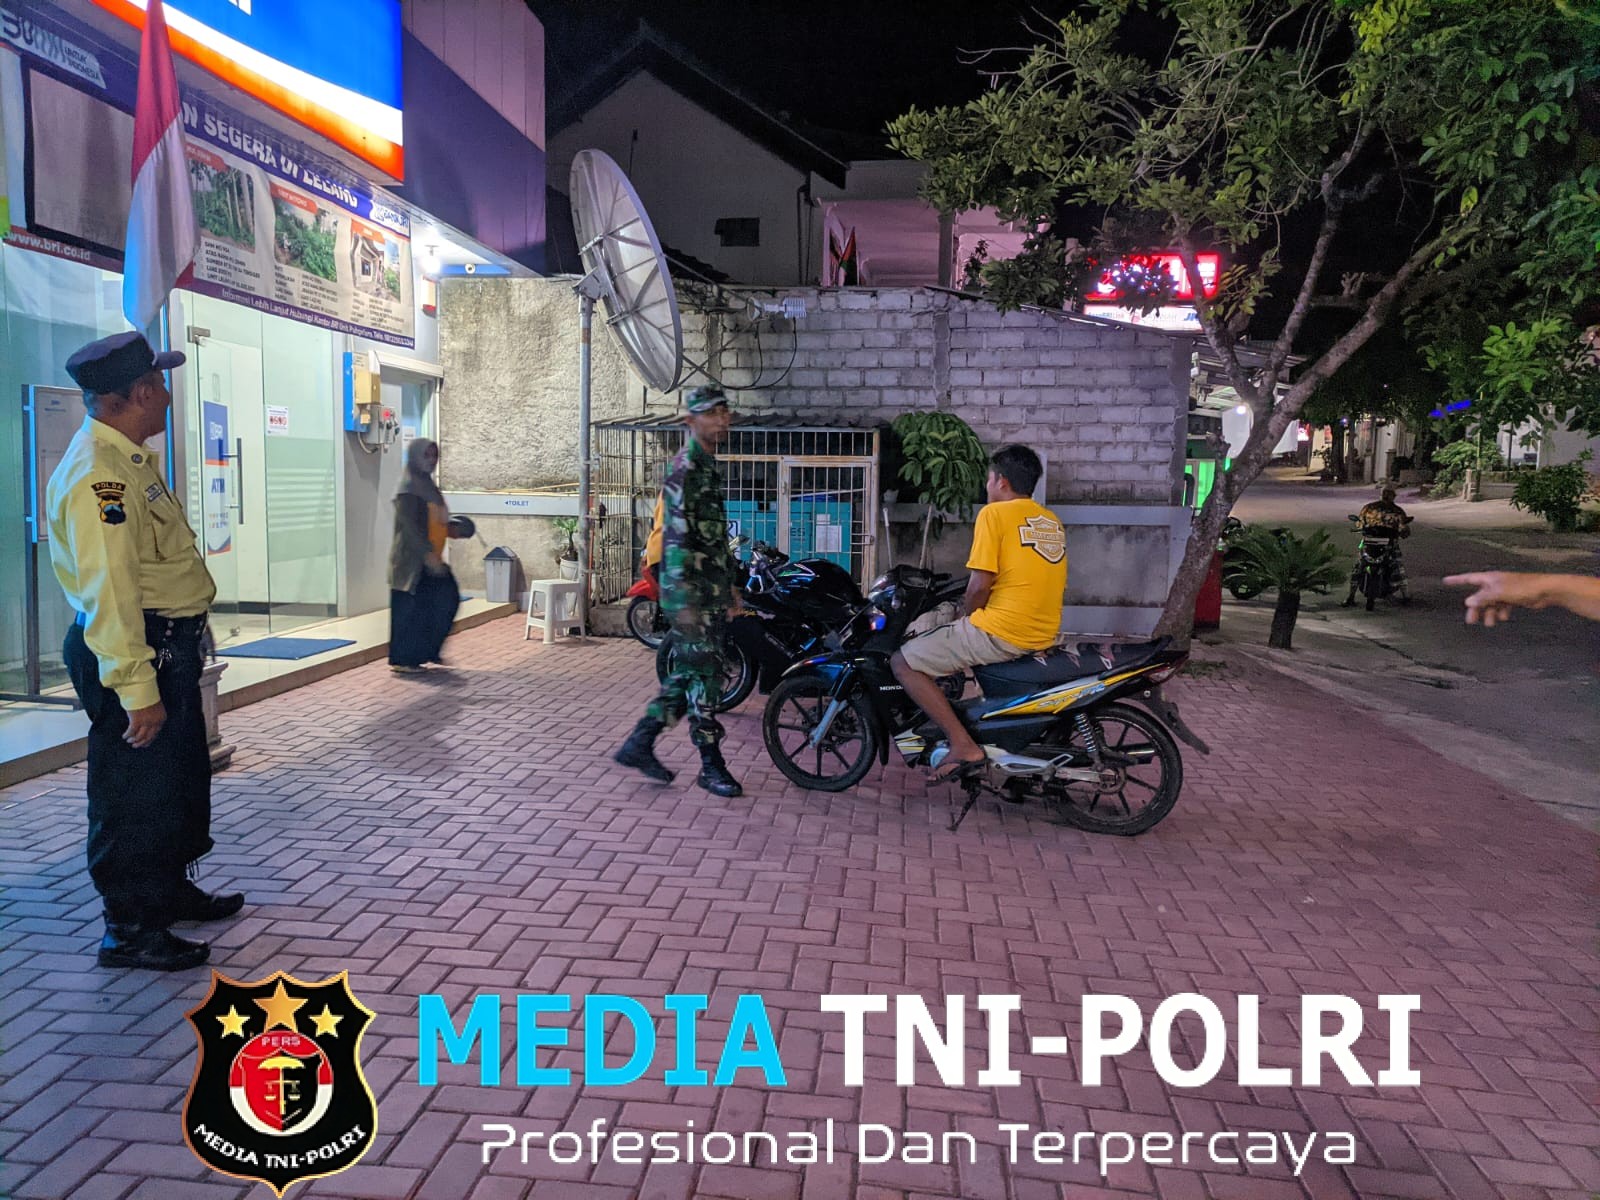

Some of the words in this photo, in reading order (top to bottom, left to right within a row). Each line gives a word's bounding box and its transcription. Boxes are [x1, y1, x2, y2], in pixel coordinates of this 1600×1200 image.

[203, 112, 278, 169] SEGERA
[6, 231, 92, 261] www.bri.co.id
[251, 298, 270, 310] Lebih
[95, 482, 123, 490] POLDA
[211, 478, 226, 494] ATM
